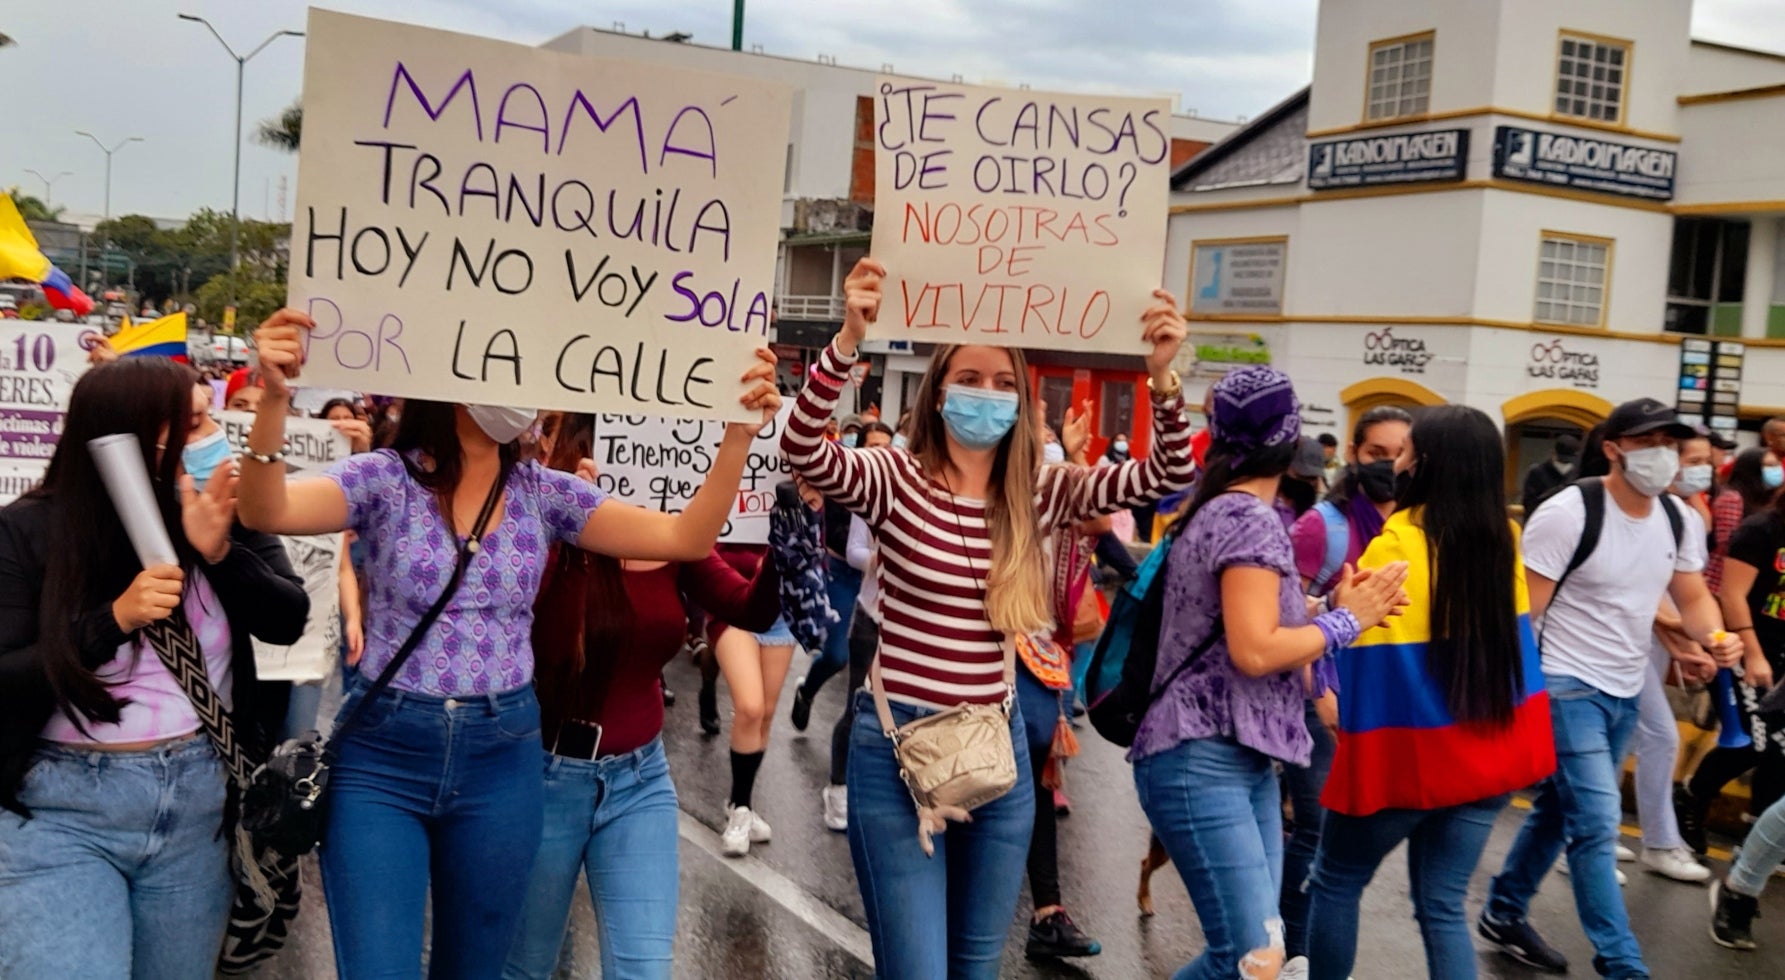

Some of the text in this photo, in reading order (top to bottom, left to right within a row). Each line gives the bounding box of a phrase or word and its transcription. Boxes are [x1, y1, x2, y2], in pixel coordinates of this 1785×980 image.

[384, 61, 738, 179] MAMÁ
[879, 82, 1168, 165] ¿TE CANSAS
[894, 150, 1137, 218] DE OIRLO?
[902, 202, 1119, 246] NOSOTRAS
[306, 206, 430, 288] HOY
[446, 236, 534, 294] NO
[978, 245, 1046, 277] DE
[902, 280, 1110, 339] VIVIRLO
[12, 332, 55, 373] 10
[301, 297, 714, 409] POR LA CALLE
[1364, 352, 1385, 366] LAS
[1527, 365, 1555, 378] LAS
[11, 435, 57, 457] violen
[599, 435, 712, 474] Tenemos
[738, 490, 776, 513] TOD
